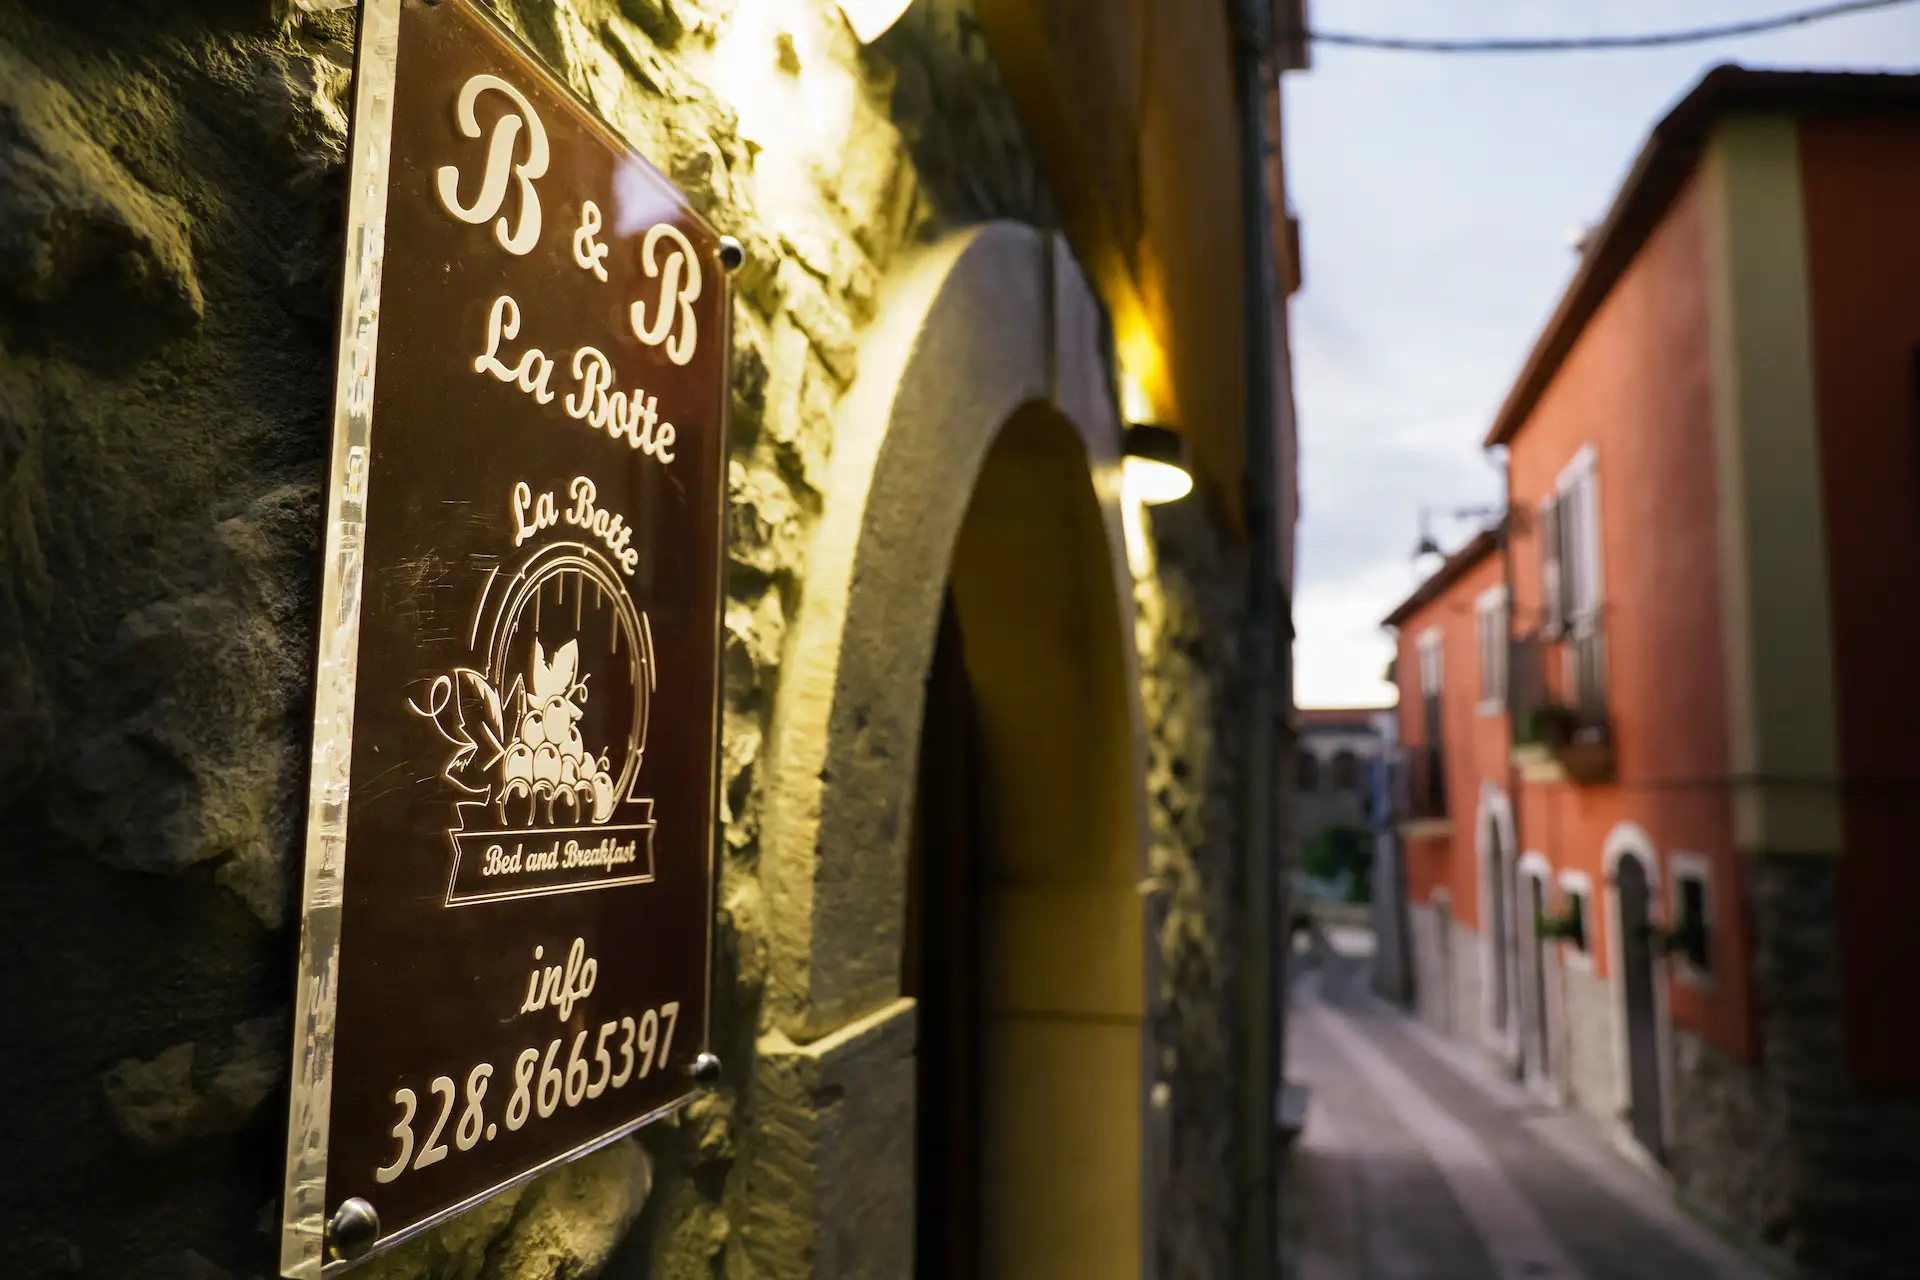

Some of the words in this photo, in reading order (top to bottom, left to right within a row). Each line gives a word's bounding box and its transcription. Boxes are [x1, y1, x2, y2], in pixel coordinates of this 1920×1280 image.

[438, 74, 550, 255] B
[573, 200, 609, 282] &
[631, 223, 702, 366] B
[475, 295, 555, 404] La
[565, 346, 677, 465] Botte
[513, 481, 559, 547] La
[566, 475, 639, 576] Botte
[482, 844, 522, 877] Bed
[525, 840, 559, 871] and
[561, 837, 636, 872] Breakfast
[520, 937, 598, 1023] info
[376, 1001, 679, 1183] 328.8665397
